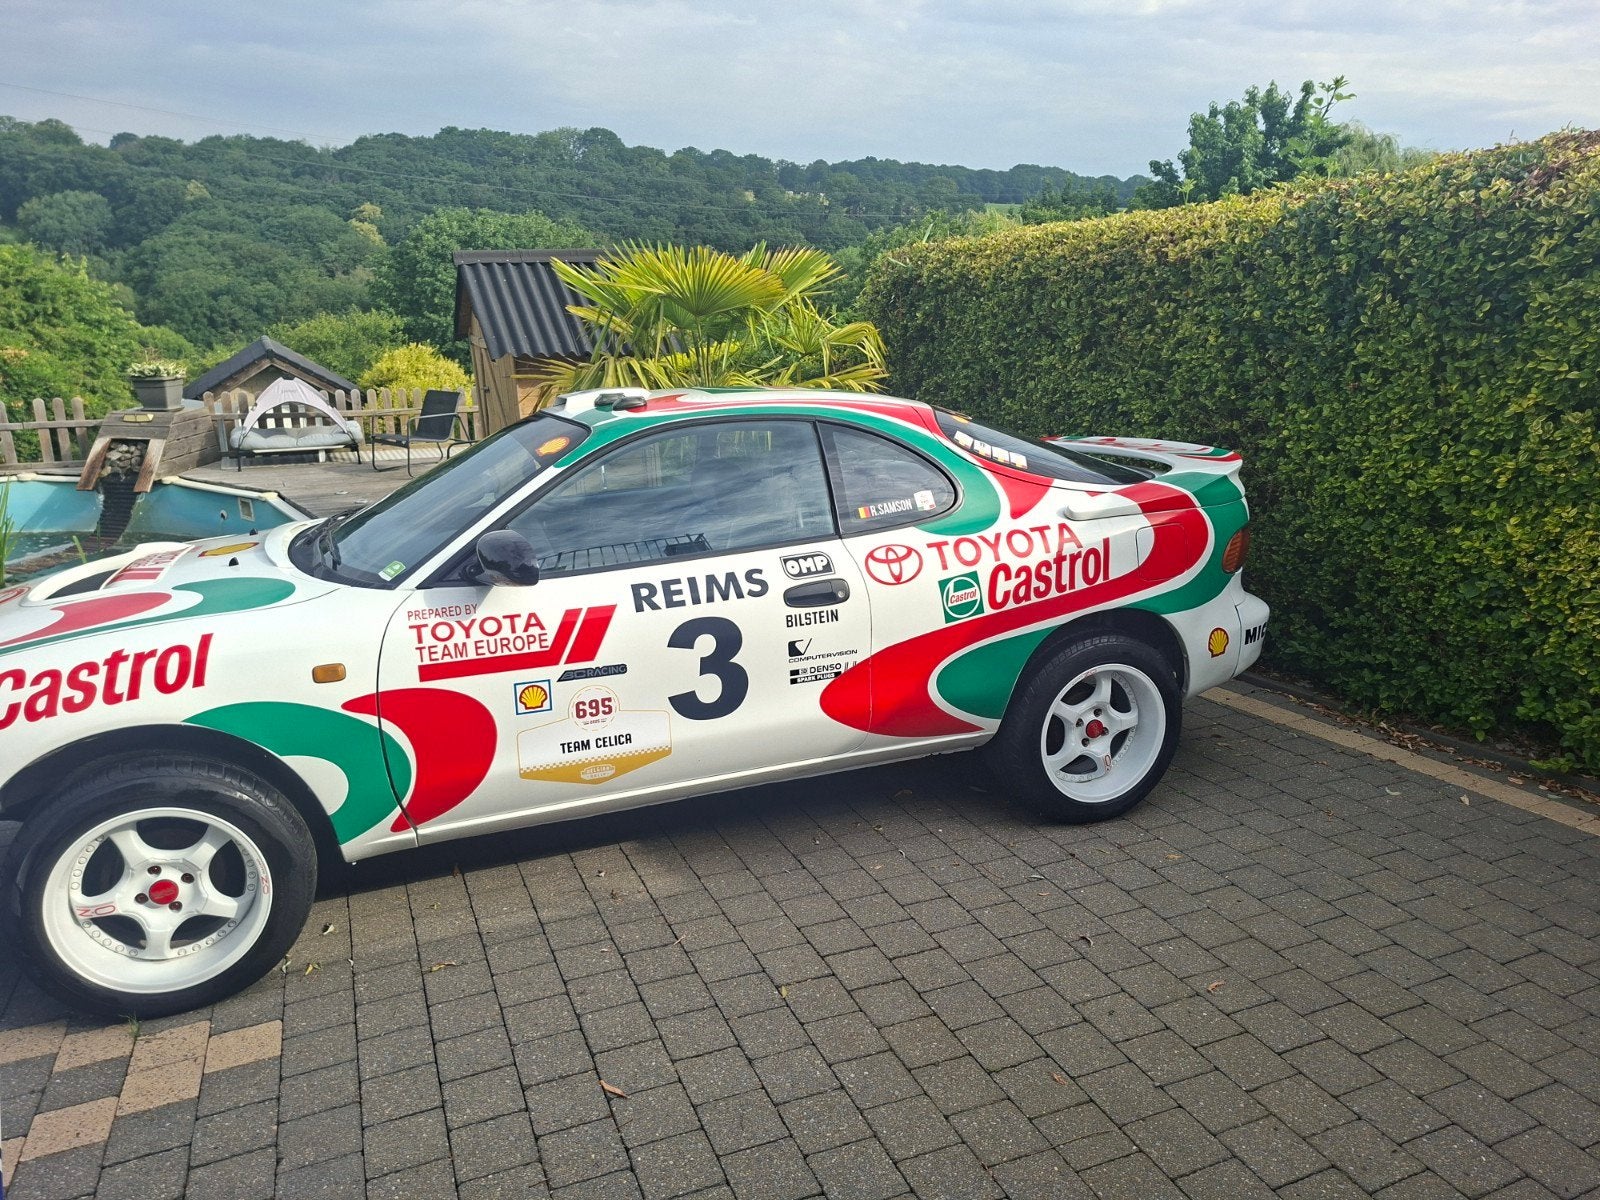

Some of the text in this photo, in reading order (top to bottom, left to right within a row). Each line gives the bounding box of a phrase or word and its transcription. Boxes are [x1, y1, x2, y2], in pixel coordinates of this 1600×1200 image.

[870, 499, 913, 517] R.SAMSON
[927, 522, 1083, 571] TOYOTA
[785, 556, 828, 577] OMP
[987, 537, 1110, 611] Castrol
[631, 568, 769, 613] REIMS
[950, 589, 977, 605] Castrol
[407, 603, 478, 622] PREPARED BY
[785, 609, 839, 628] BILSTEIN
[408, 612, 546, 645] TOYOTA
[415, 632, 550, 663] TEAM EUROPE
[788, 649, 858, 664] COMPUTERVISION
[667, 616, 749, 721] 3
[809, 662, 842, 674] DENSO
[0, 633, 214, 730] Castrol
[575, 697, 613, 719] 695
[560, 734, 632, 754] TEAM CELICA
